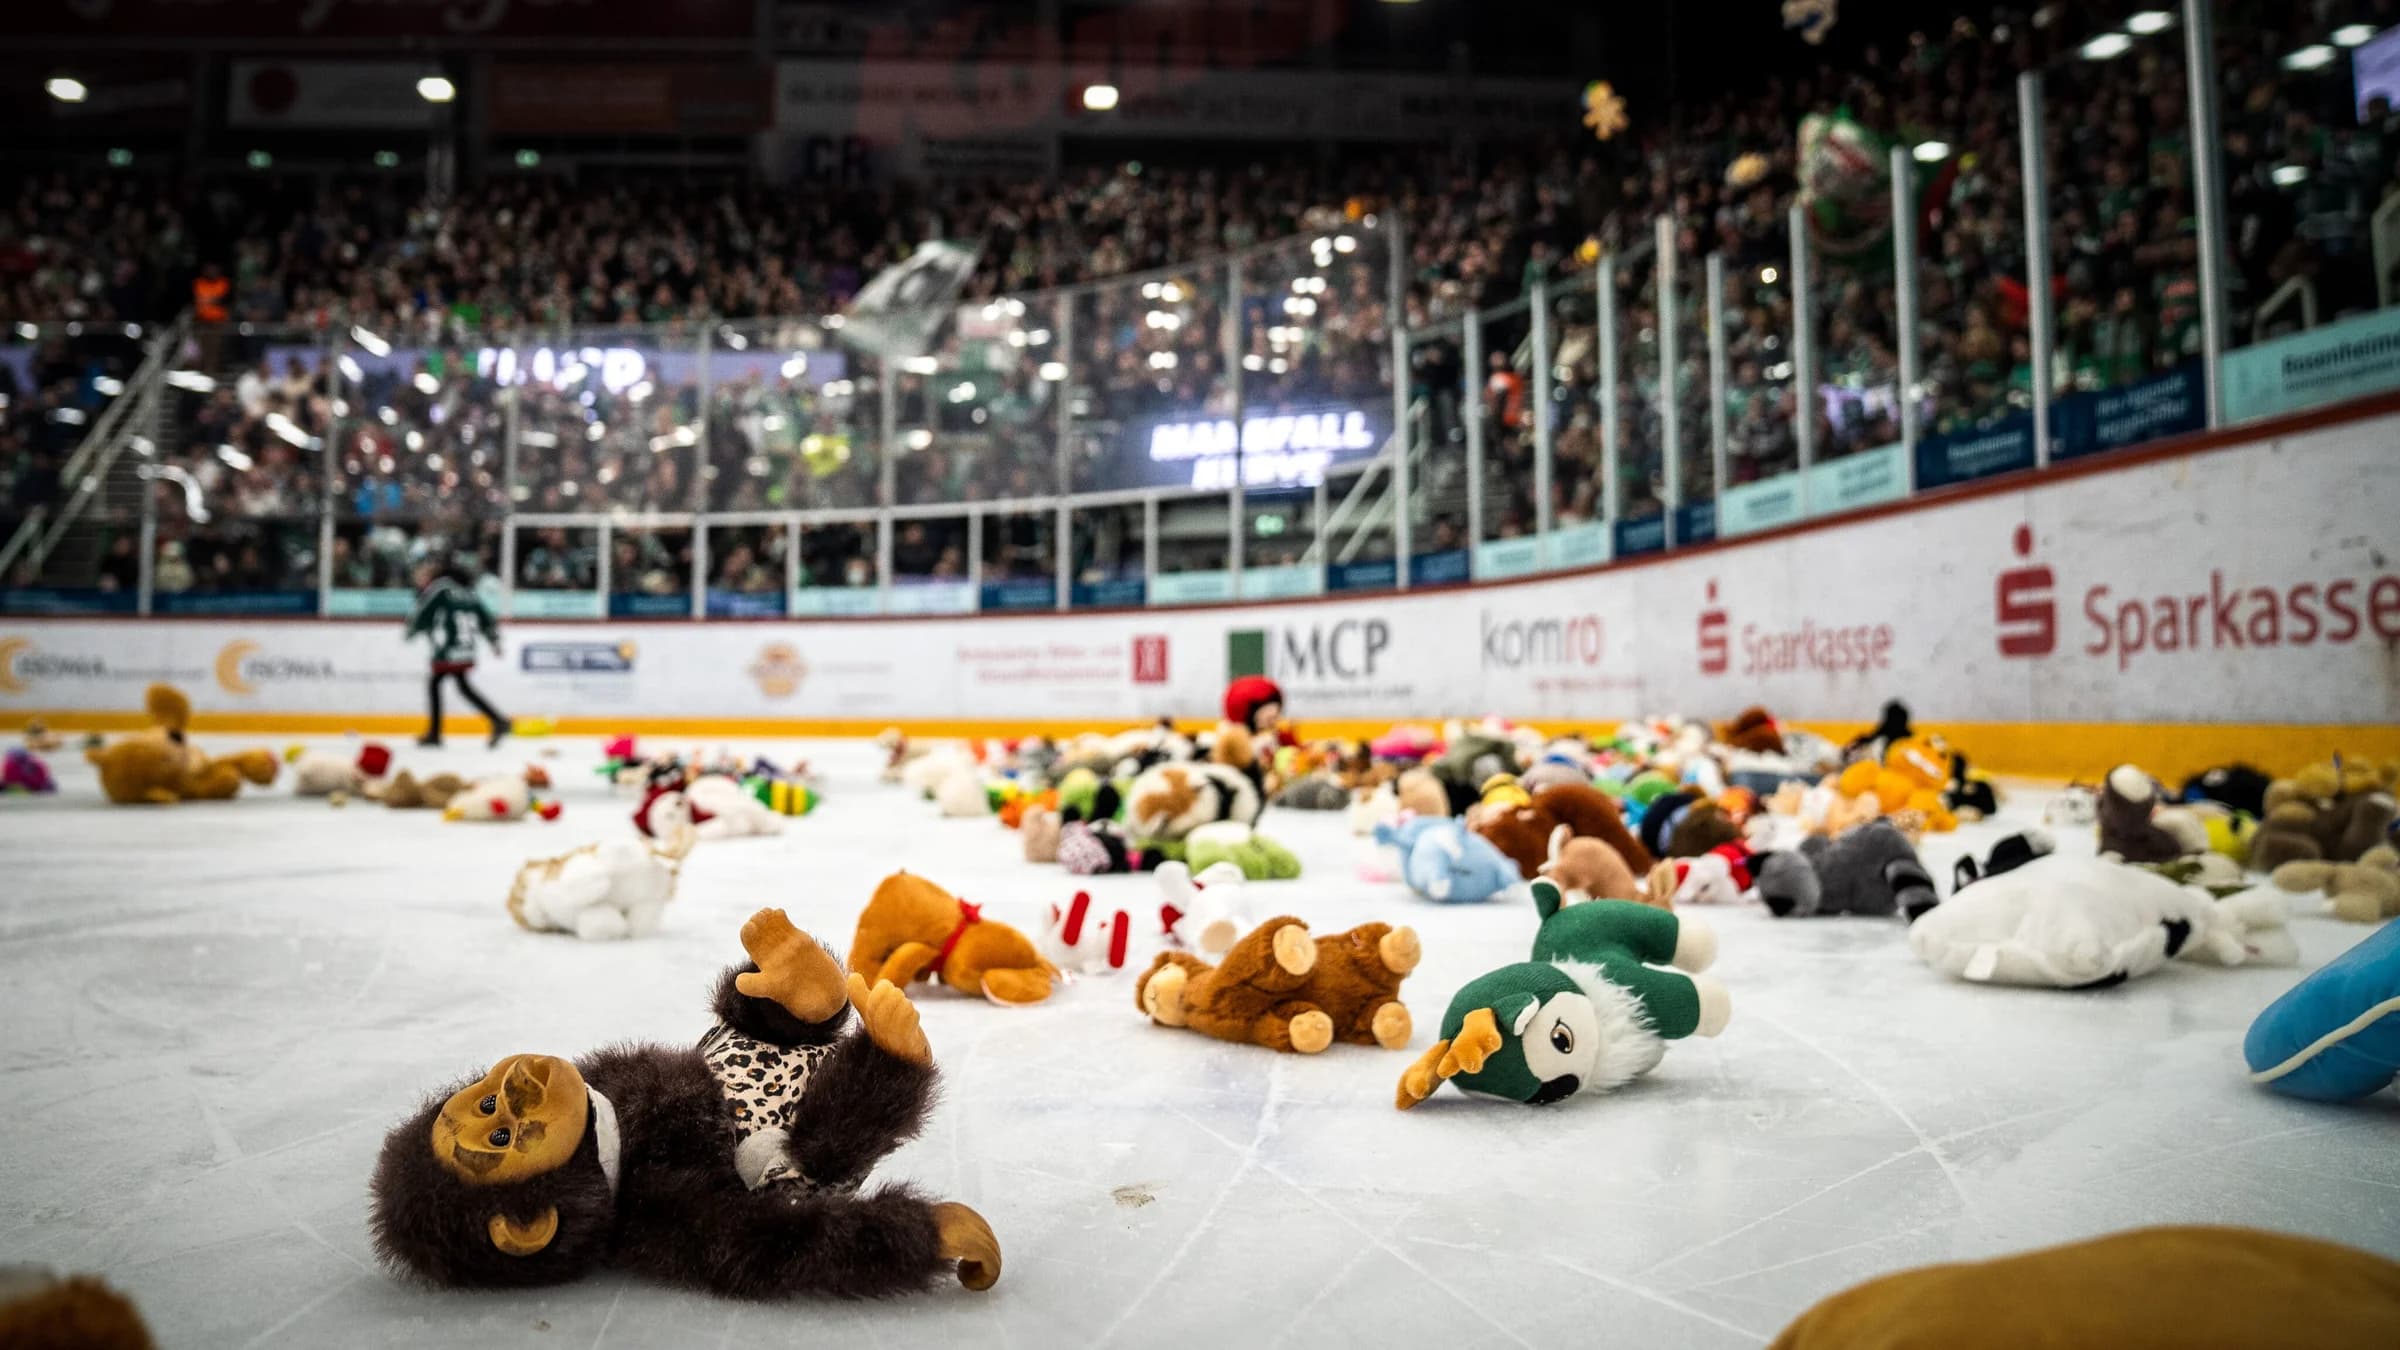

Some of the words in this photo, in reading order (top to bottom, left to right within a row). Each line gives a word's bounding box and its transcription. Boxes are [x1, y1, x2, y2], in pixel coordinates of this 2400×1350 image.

[1277, 617, 1390, 679] MCP
[1480, 609, 1605, 671] komro
[1741, 617, 1894, 676] Sparkasse
[2083, 567, 2400, 673] Sparkasse
